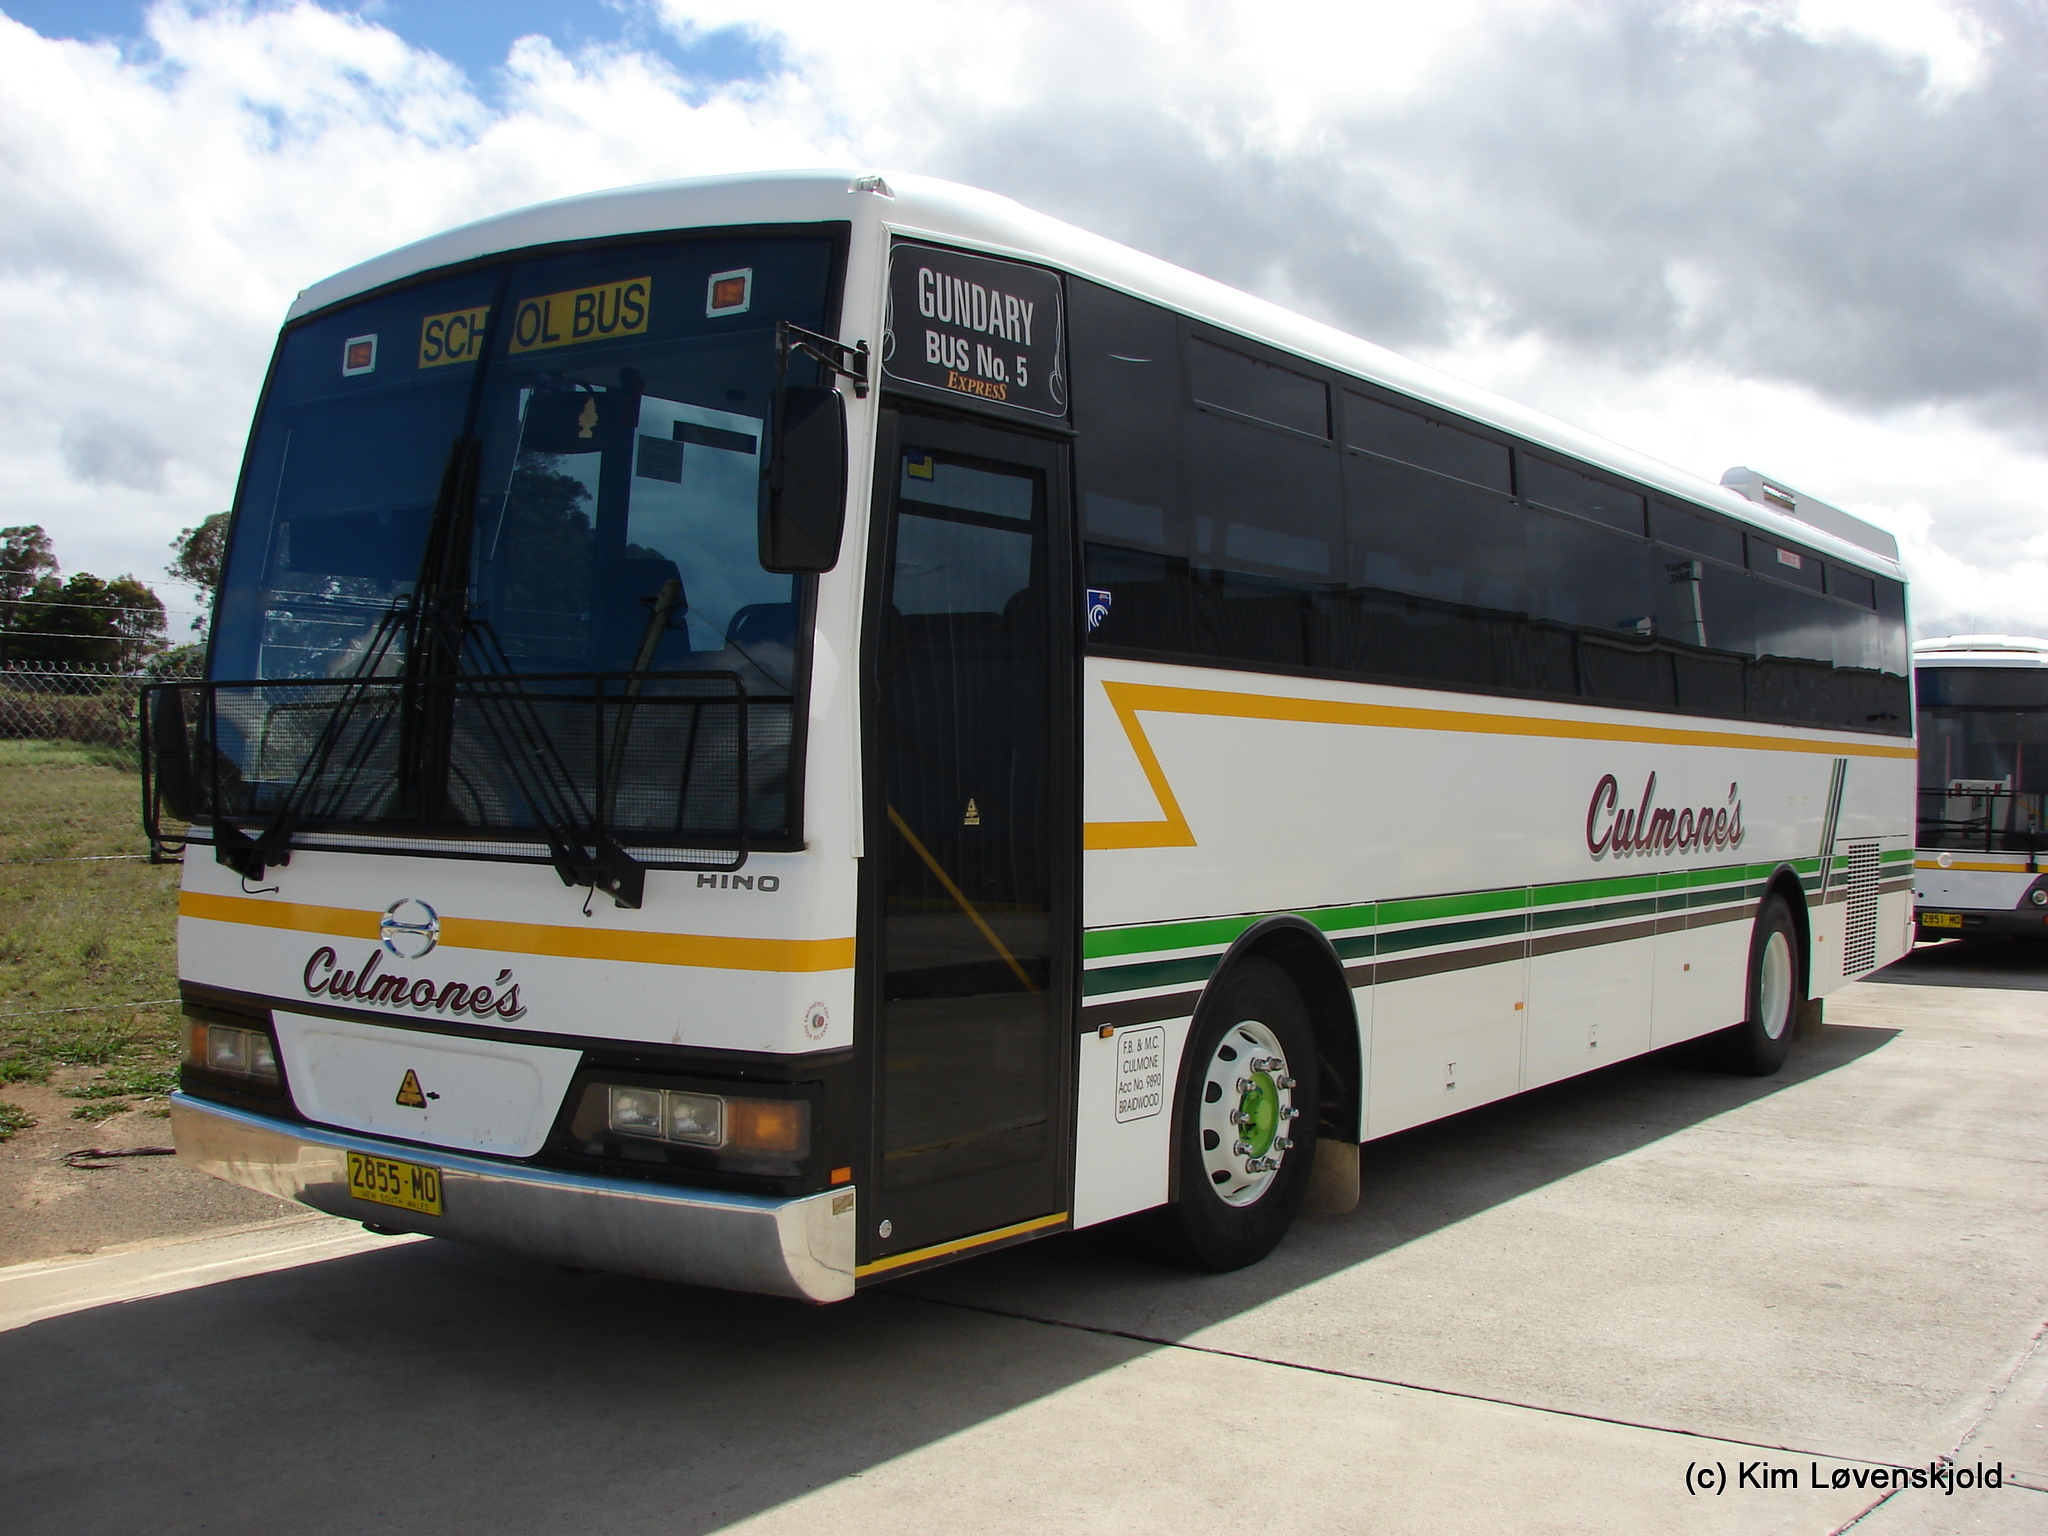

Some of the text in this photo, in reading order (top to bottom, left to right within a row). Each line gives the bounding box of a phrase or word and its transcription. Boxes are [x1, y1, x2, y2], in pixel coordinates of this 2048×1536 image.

[918, 267, 1034, 346] GUNDARY
[423, 283, 645, 362] SCHOL BUS
[925, 329, 1028, 388] BUS No. 5
[947, 371, 1008, 401] EXPRESS
[1586, 770, 1744, 862] Culmone's
[697, 873, 780, 892] HINO
[303, 946, 527, 1021] Culmone's
[1136, 1038, 1143, 1052] &
[1122, 1054, 1159, 1074] CULMONE
[1118, 1081, 1132, 1094] Acc
[1146, 1073, 1162, 1088] 9890
[1118, 1092, 1160, 1114] BRAIDWOOD
[362, 1190, 430, 1212] NEW SOUTH WALES
